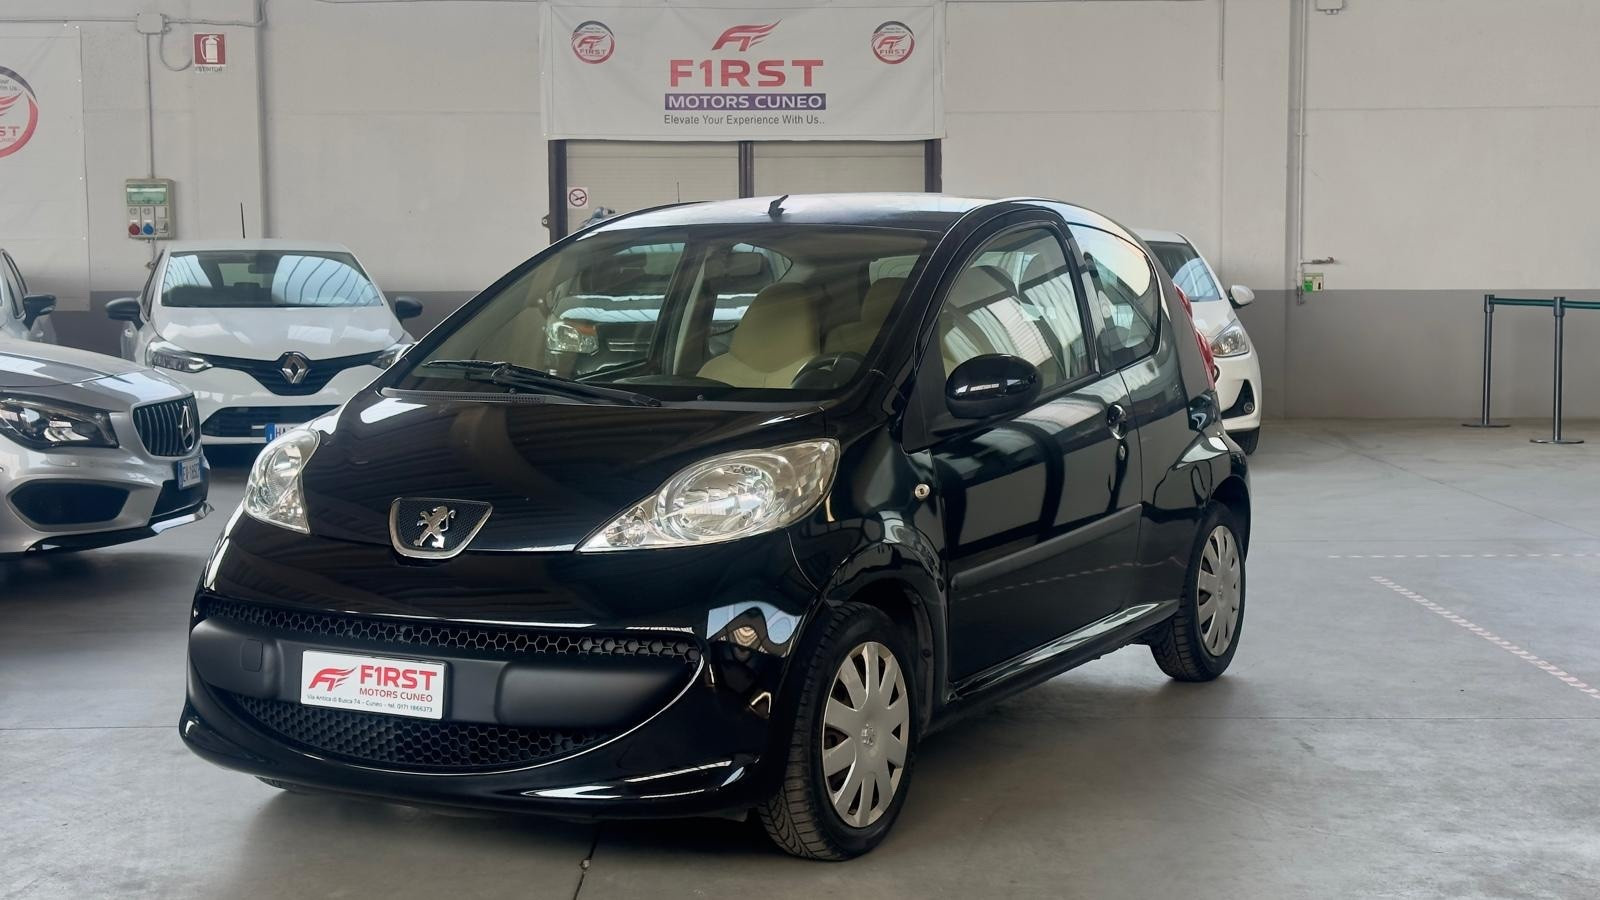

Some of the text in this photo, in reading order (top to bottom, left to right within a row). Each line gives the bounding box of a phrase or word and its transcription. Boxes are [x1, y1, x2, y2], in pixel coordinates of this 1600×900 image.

[670, 59, 824, 87] F1RST
[668, 95, 823, 108] MOTORS CUNEO
[664, 115, 699, 125] Elevate
[702, 115, 724, 125] Your
[727, 115, 779, 126] Experience
[782, 114, 803, 125] With
[359, 664, 437, 691] F1RST
[359, 687, 433, 703] MOTORS CUNEO
